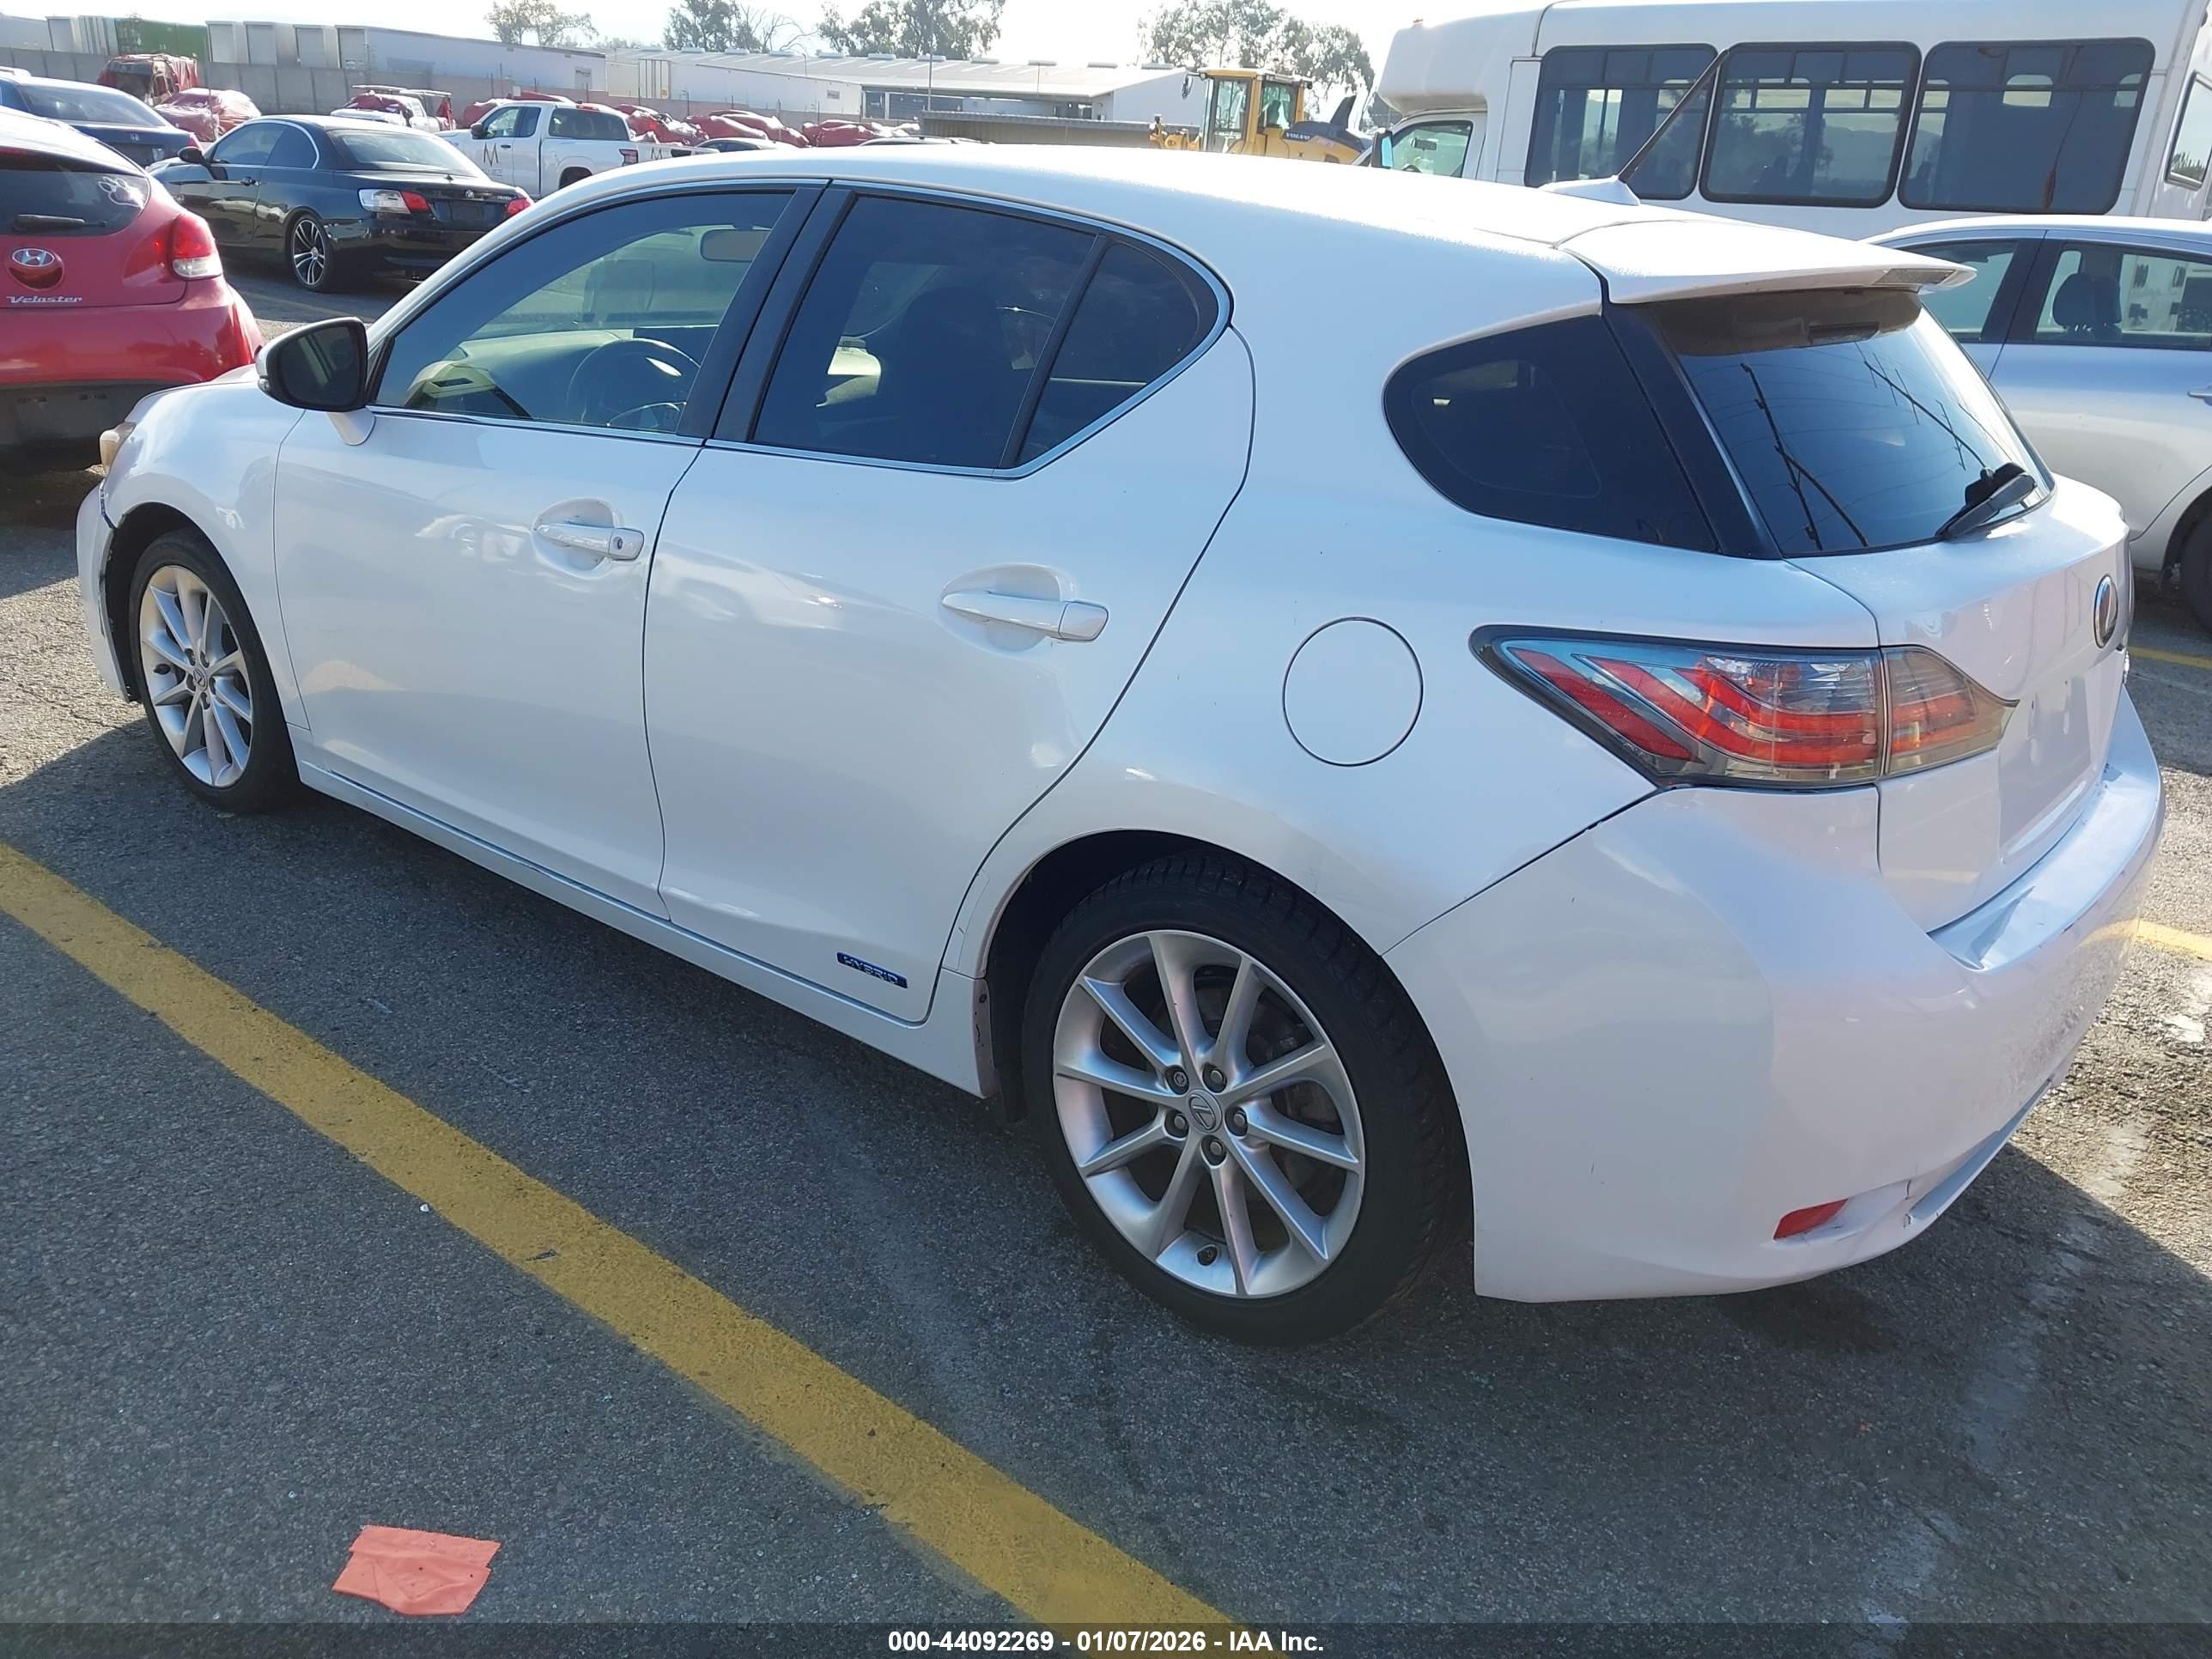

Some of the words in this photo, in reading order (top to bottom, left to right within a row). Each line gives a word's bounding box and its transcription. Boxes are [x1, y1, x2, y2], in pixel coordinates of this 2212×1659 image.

[1285, 131, 1310, 140] VOLVO
[6, 295, 83, 303] Veloster
[842, 955, 898, 985] HYBRID
